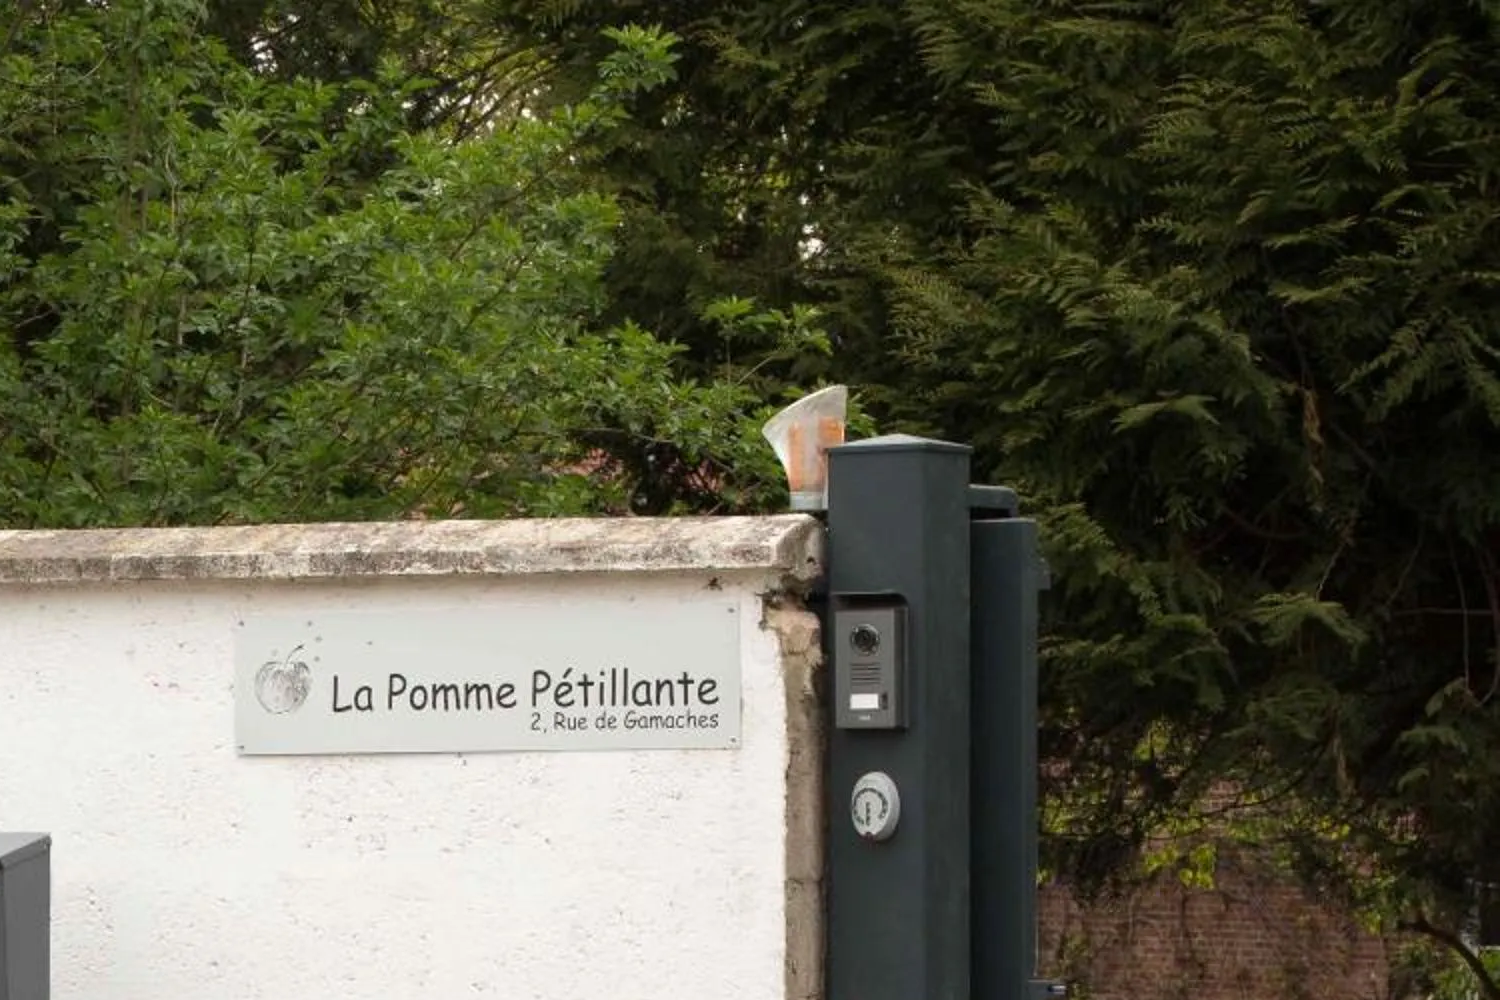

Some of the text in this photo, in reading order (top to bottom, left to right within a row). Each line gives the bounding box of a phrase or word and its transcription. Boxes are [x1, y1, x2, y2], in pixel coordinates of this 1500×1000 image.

[331, 666, 721, 713] La Pomme Pétillante
[530, 707, 721, 734] 2, Rue de Gamaches
